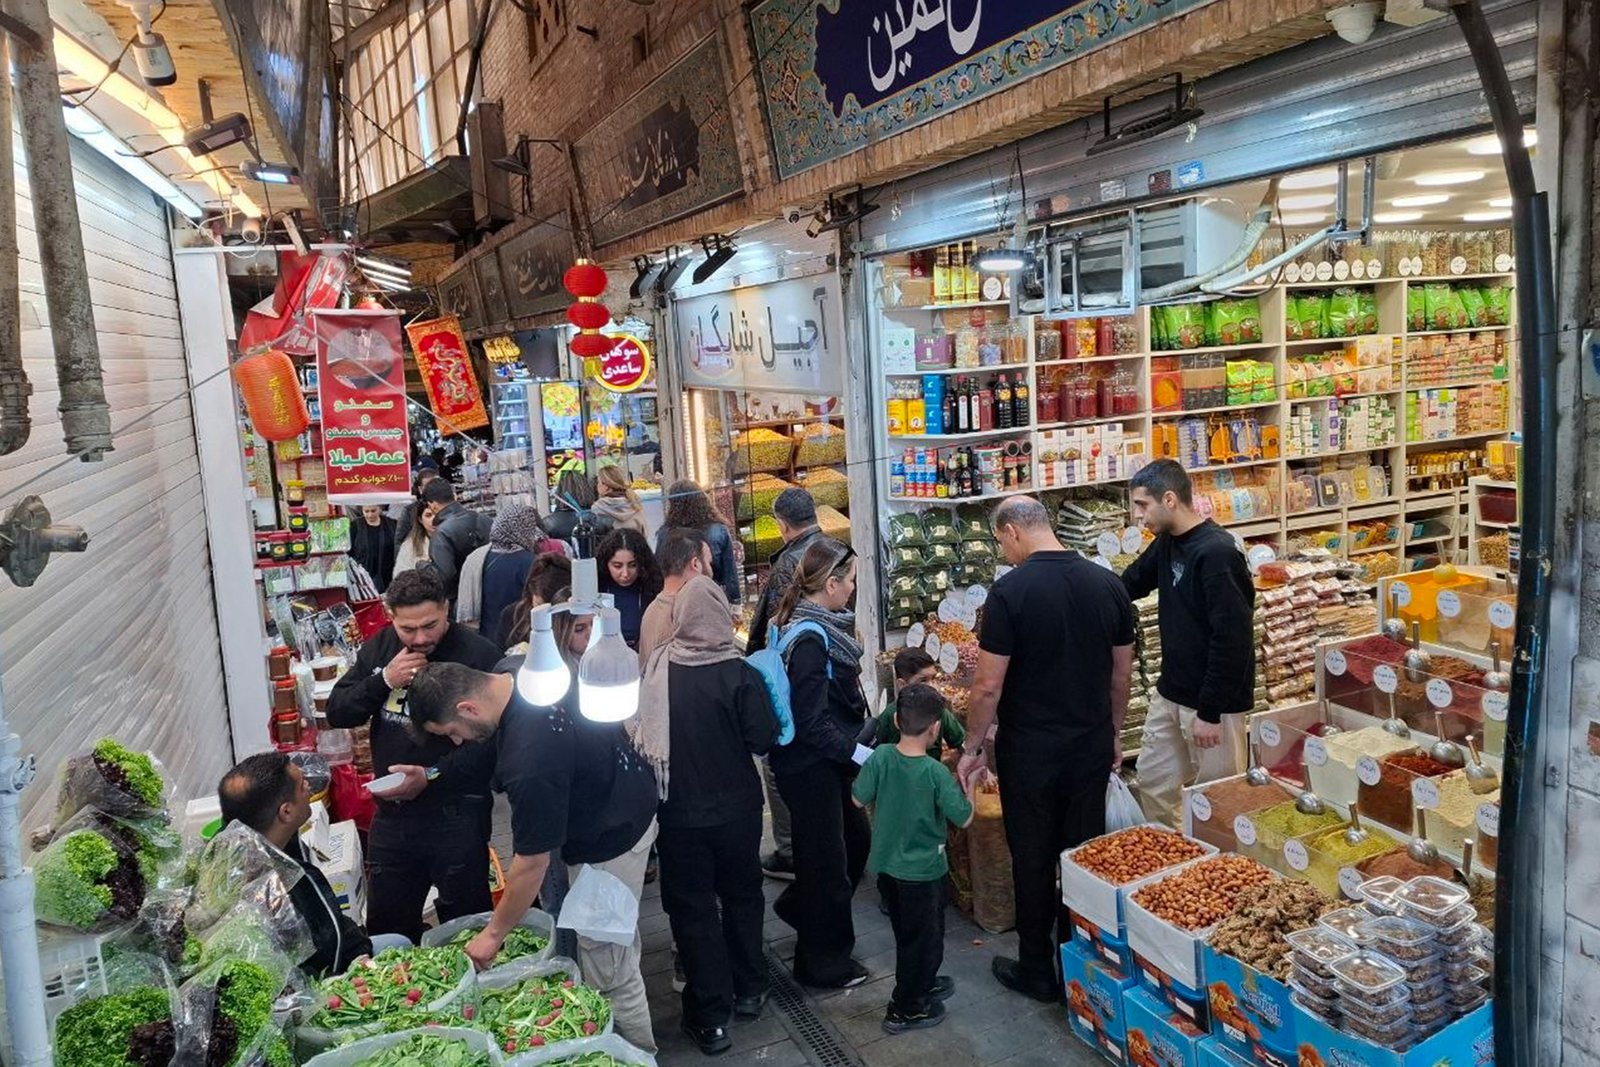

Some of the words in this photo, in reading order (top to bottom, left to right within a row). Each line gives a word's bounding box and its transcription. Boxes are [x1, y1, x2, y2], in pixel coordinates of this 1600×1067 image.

[759, 287, 828, 369] آجیل
[688, 304, 753, 369] شایگان
[600, 339, 639, 361] سوهن
[602, 362, 641, 379] ساعدی
[334, 398, 394, 412] سمنو
[361, 414, 371, 426] و
[326, 427, 364, 440] سمنو
[328, 447, 366, 471] لیلا
[366, 450, 406, 465] عمه
[361, 474, 386, 486] جوانه
